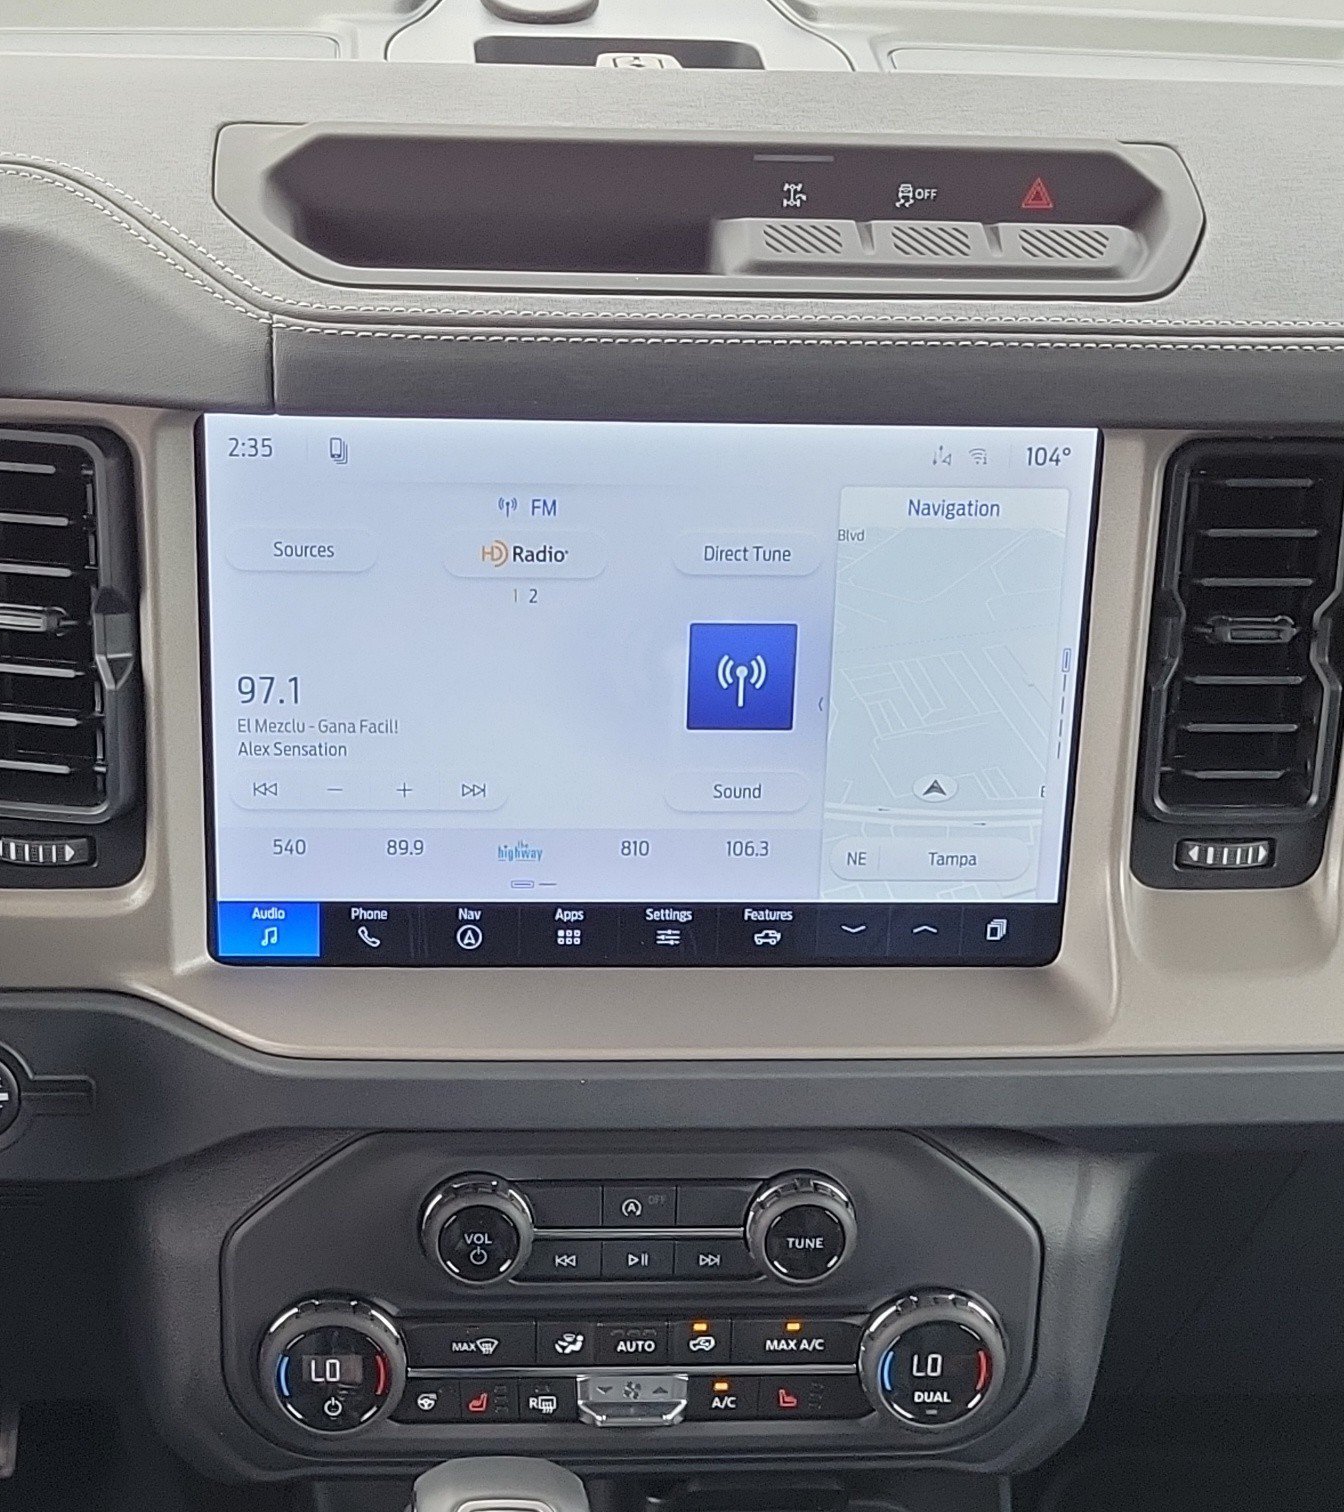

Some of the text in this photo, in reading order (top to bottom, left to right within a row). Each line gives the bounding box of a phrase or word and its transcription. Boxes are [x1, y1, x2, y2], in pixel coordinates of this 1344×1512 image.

[915, 188, 937, 200] OFF
[228, 437, 273, 459] 2:35
[1026, 446, 1072, 467] 104°
[530, 498, 557, 518] FM
[907, 499, 1001, 519] Navigation
[838, 529, 865, 543] Blvd
[273, 541, 335, 558] Sources
[482, 543, 565, 564] HD Radio
[703, 545, 792, 563] Direct Tune
[529, 588, 538, 604] 2
[237, 675, 301, 705] 97.1
[237, 718, 252, 734] El
[255, 718, 305, 735] Mezclu
[318, 719, 356, 735] Gana
[359, 719, 399, 735] Facil!
[238, 742, 348, 758] Alex Sensation
[713, 784, 762, 800] Sound
[273, 838, 306, 856] 540
[386, 839, 425, 856] 89.9
[497, 845, 543, 862] highway
[621, 839, 650, 857] 810
[726, 840, 770, 857] 106.3
[846, 851, 867, 867] NE
[928, 851, 977, 869] Tampa
[252, 907, 286, 921] Audio
[350, 908, 388, 921] Phone
[458, 908, 482, 921] Nav
[555, 908, 585, 924] Apps
[645, 909, 693, 924] Settings
[744, 909, 794, 922] Features
[464, 1232, 493, 1246] VOL
[786, 1236, 824, 1250] TUNE
[451, 1342, 477, 1352] MAX
[616, 1339, 656, 1353] AUTO
[765, 1338, 825, 1351] MAX A/C
[310, 1359, 341, 1382] LO
[912, 1353, 943, 1377] LO
[711, 1396, 737, 1409] A/C
[913, 1391, 952, 1403] DUAL
